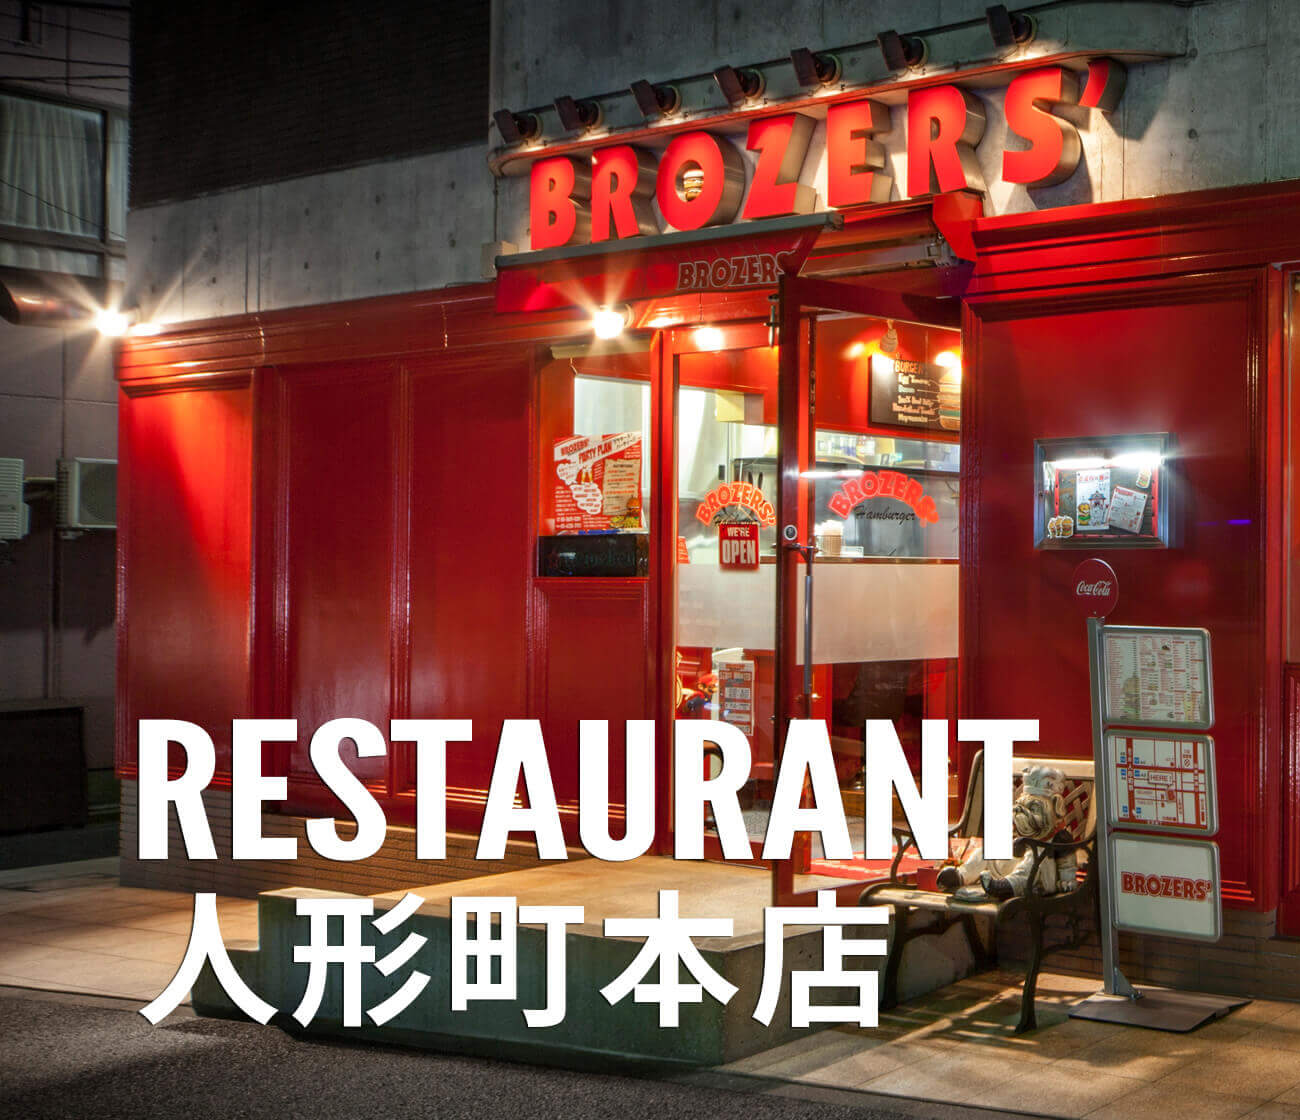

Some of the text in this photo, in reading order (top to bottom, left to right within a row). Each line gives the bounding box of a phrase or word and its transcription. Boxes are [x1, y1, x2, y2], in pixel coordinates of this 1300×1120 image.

[530, 57, 1112, 251] BROZERS'
[853, 504, 917, 525] Hamburger
[727, 527, 750, 537] WE'RE
[722, 540, 757, 565] OPEN
[1121, 871, 1213, 902] BROZERS'
